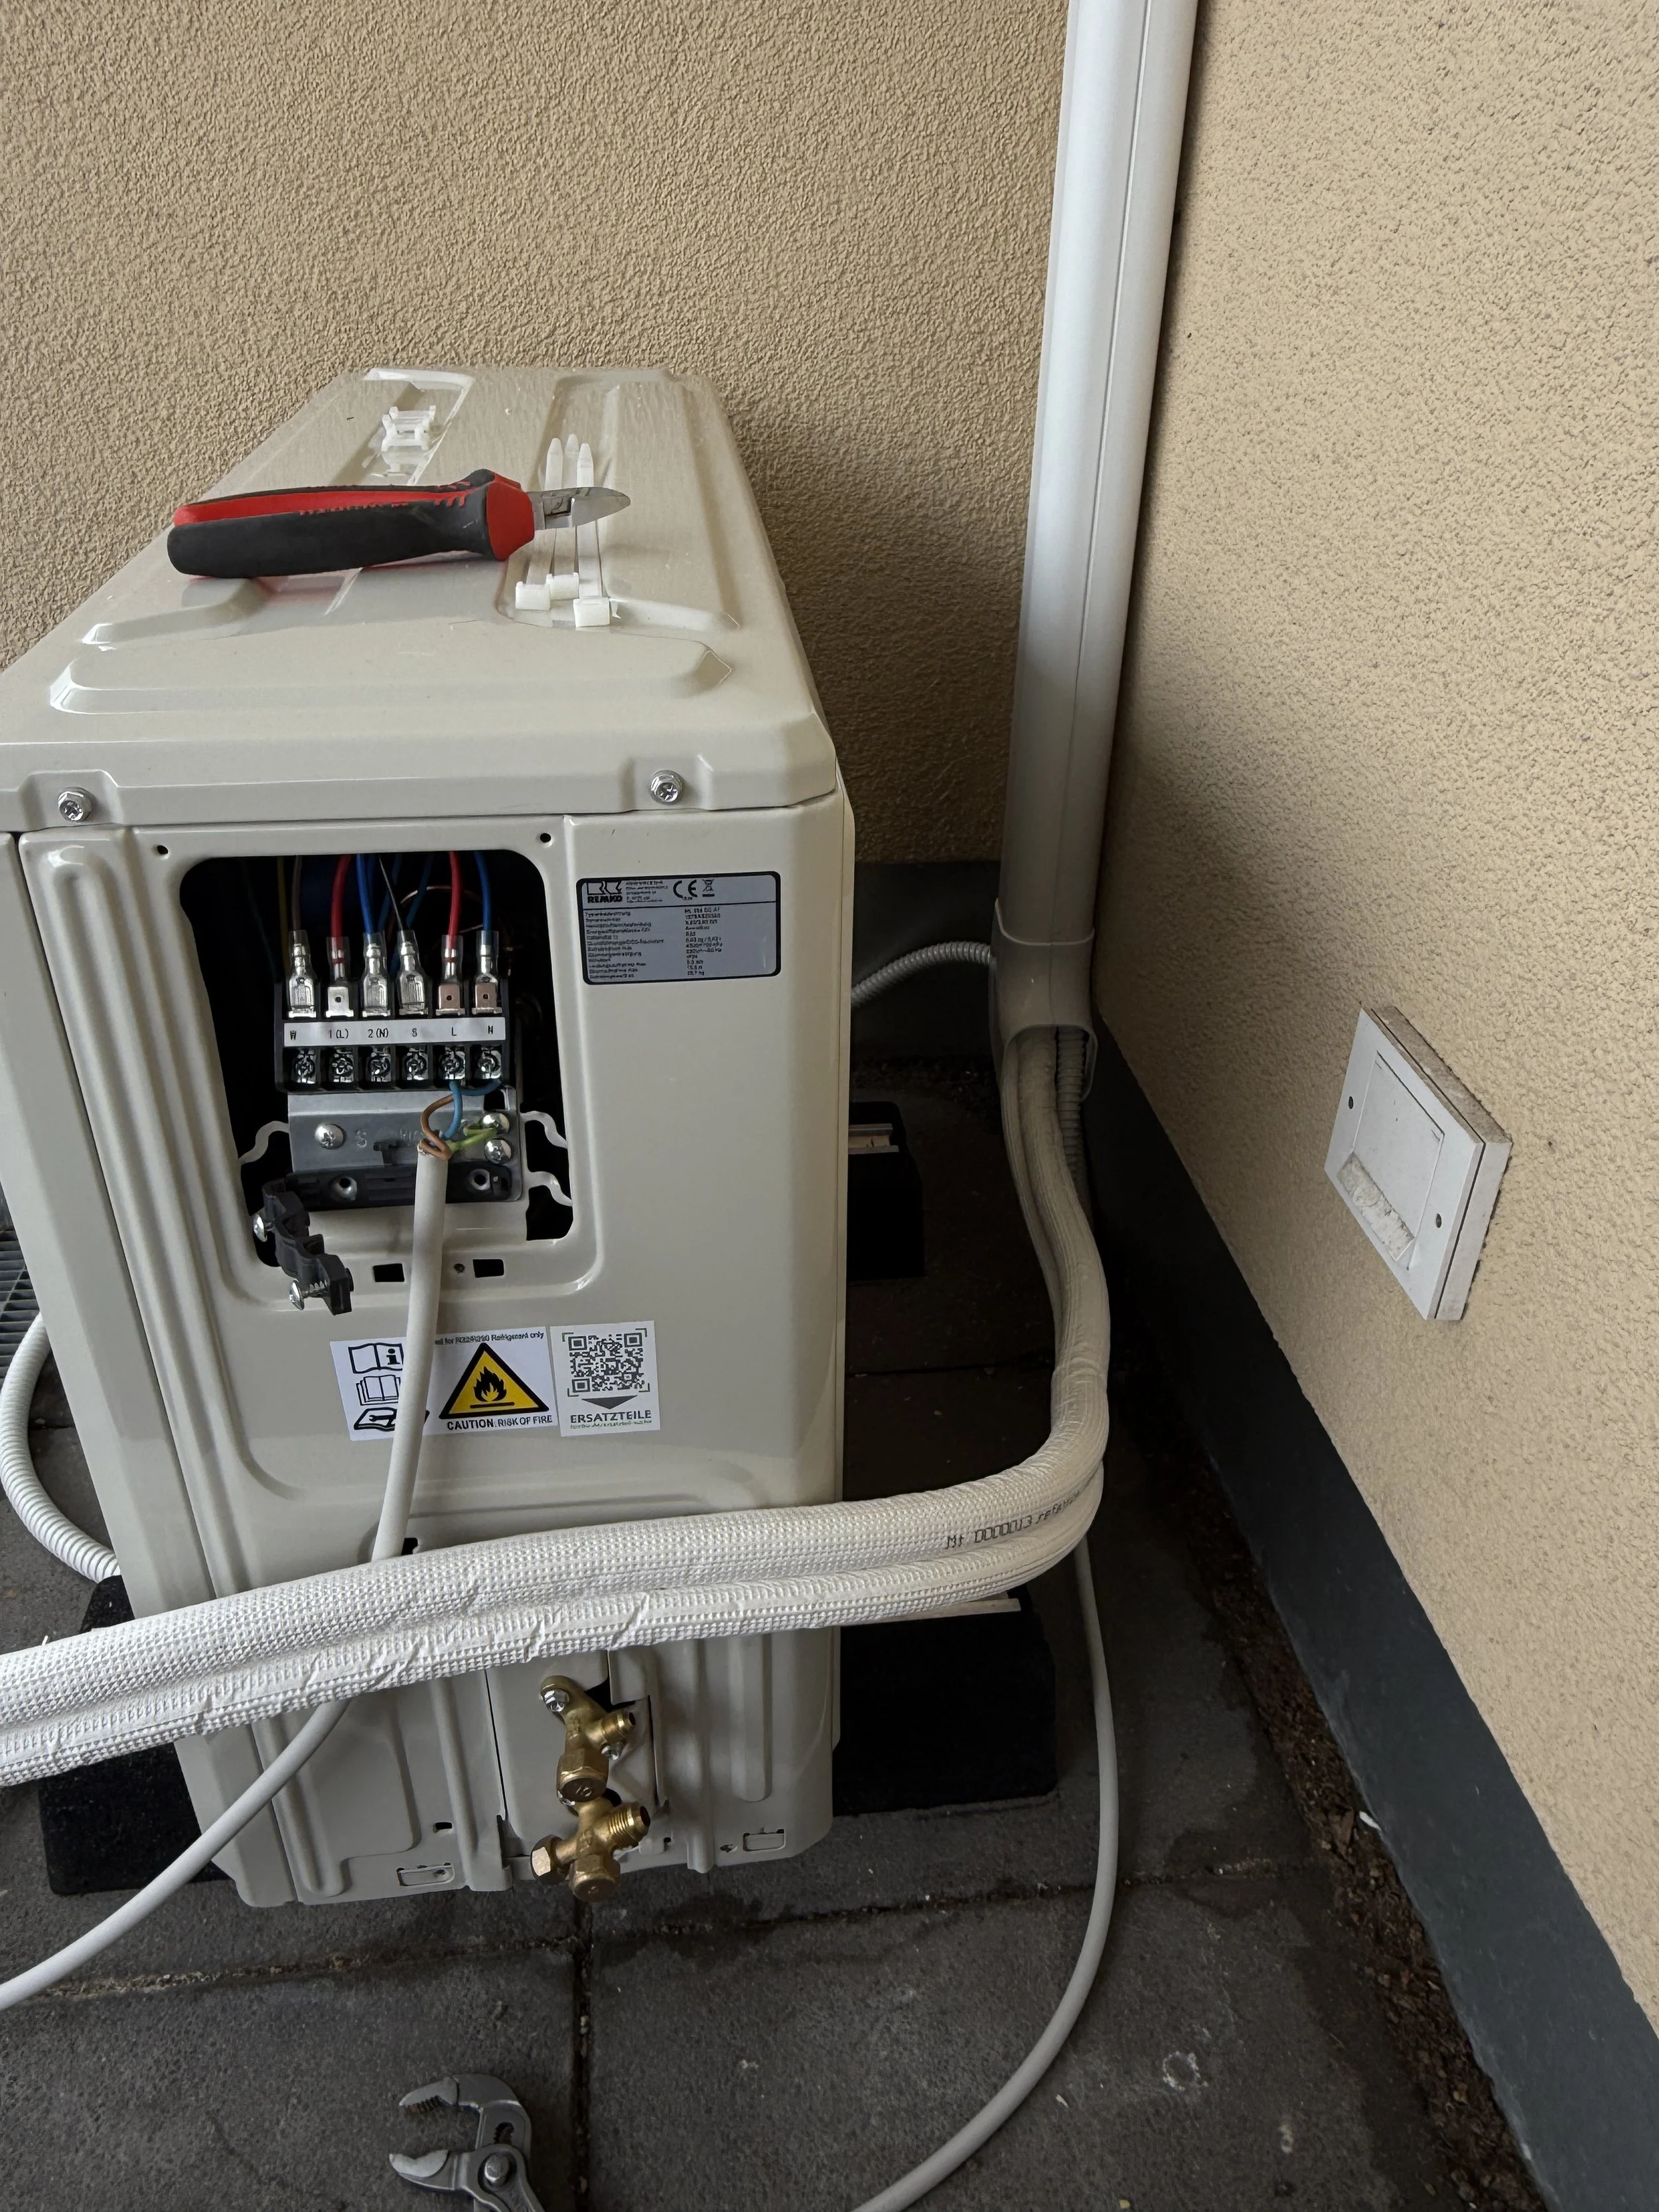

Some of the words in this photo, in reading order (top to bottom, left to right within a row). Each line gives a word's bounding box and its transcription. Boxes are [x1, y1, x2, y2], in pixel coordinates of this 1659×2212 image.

[587, 895, 623, 903] REMKO
[498, 1418, 519, 1428] RISK
[519, 1416, 532, 1426] OF
[533, 1414, 553, 1424] FIRE
[570, 1410, 652, 1424] ERSATZTEILE
